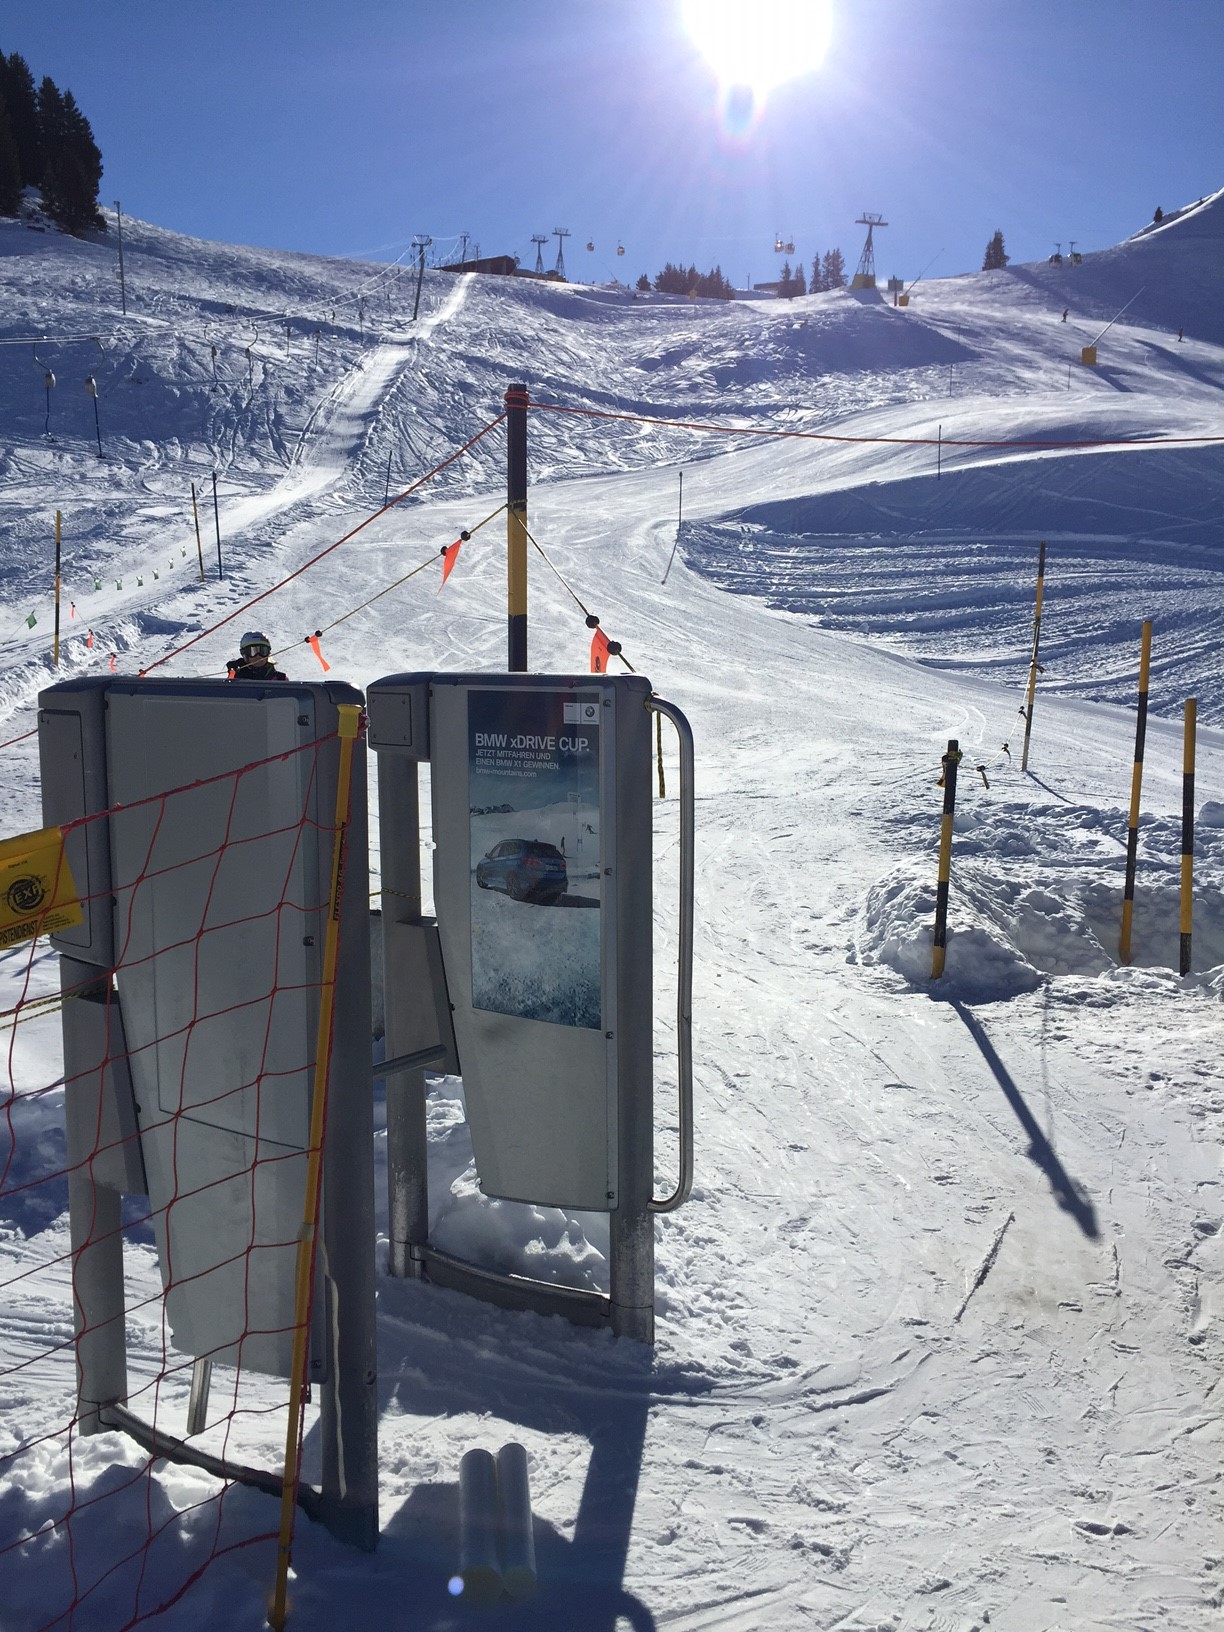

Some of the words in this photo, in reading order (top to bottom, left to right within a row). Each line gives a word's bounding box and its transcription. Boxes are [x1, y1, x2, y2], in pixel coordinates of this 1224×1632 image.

[475, 733, 507, 748] BMW
[510, 735, 556, 750] xDRIVE
[559, 737, 590, 752] CUP.
[475, 749, 496, 757] JETZT
[496, 750, 535, 760] MITFAHREN
[535, 752, 551, 760] UND
[475, 758, 495, 766] EINEN
[496, 759, 513, 767] BMW
[523, 761, 561, 770] GEWINNEN.
[475, 767, 538, 778] bmw-mountains.com
